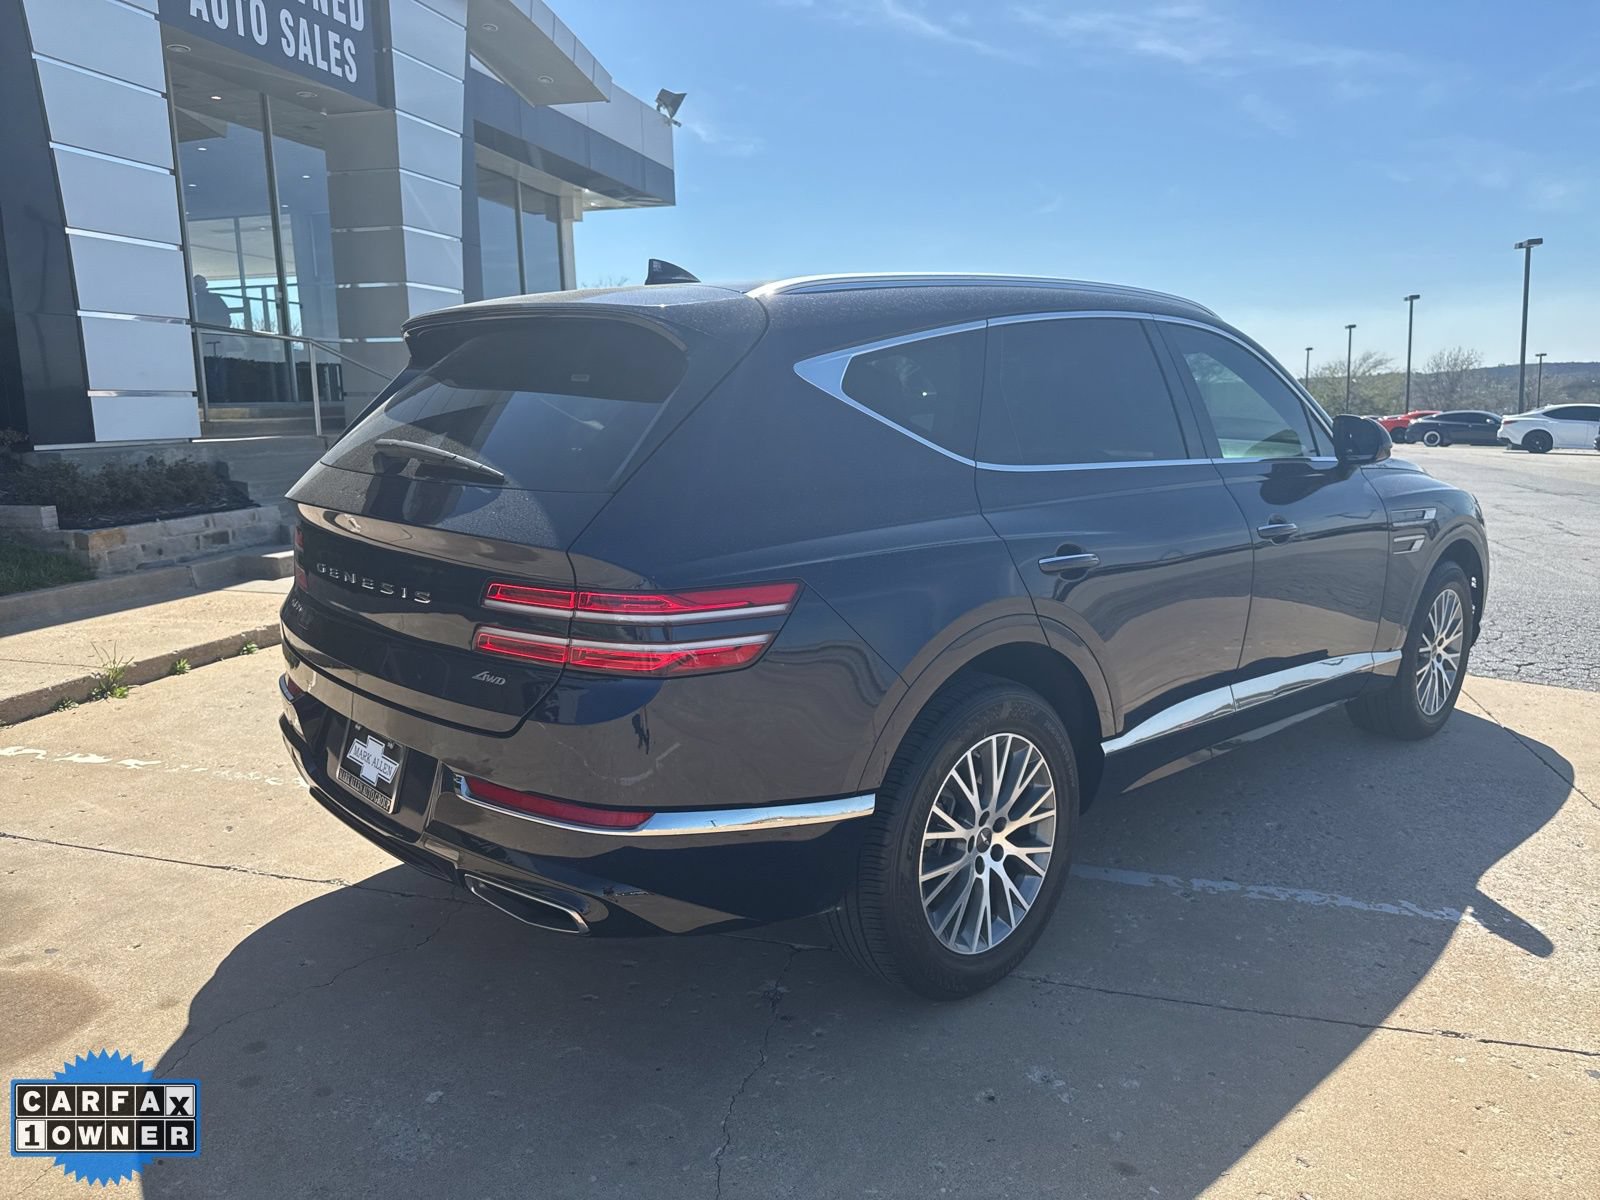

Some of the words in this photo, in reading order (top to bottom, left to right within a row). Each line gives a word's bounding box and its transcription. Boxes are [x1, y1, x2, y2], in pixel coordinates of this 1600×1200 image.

[280, 8, 358, 83] SALES
[316, 563, 431, 604] GENESIS
[353, 744, 372, 765] MARK
[371, 756, 394, 777] ALLEN
